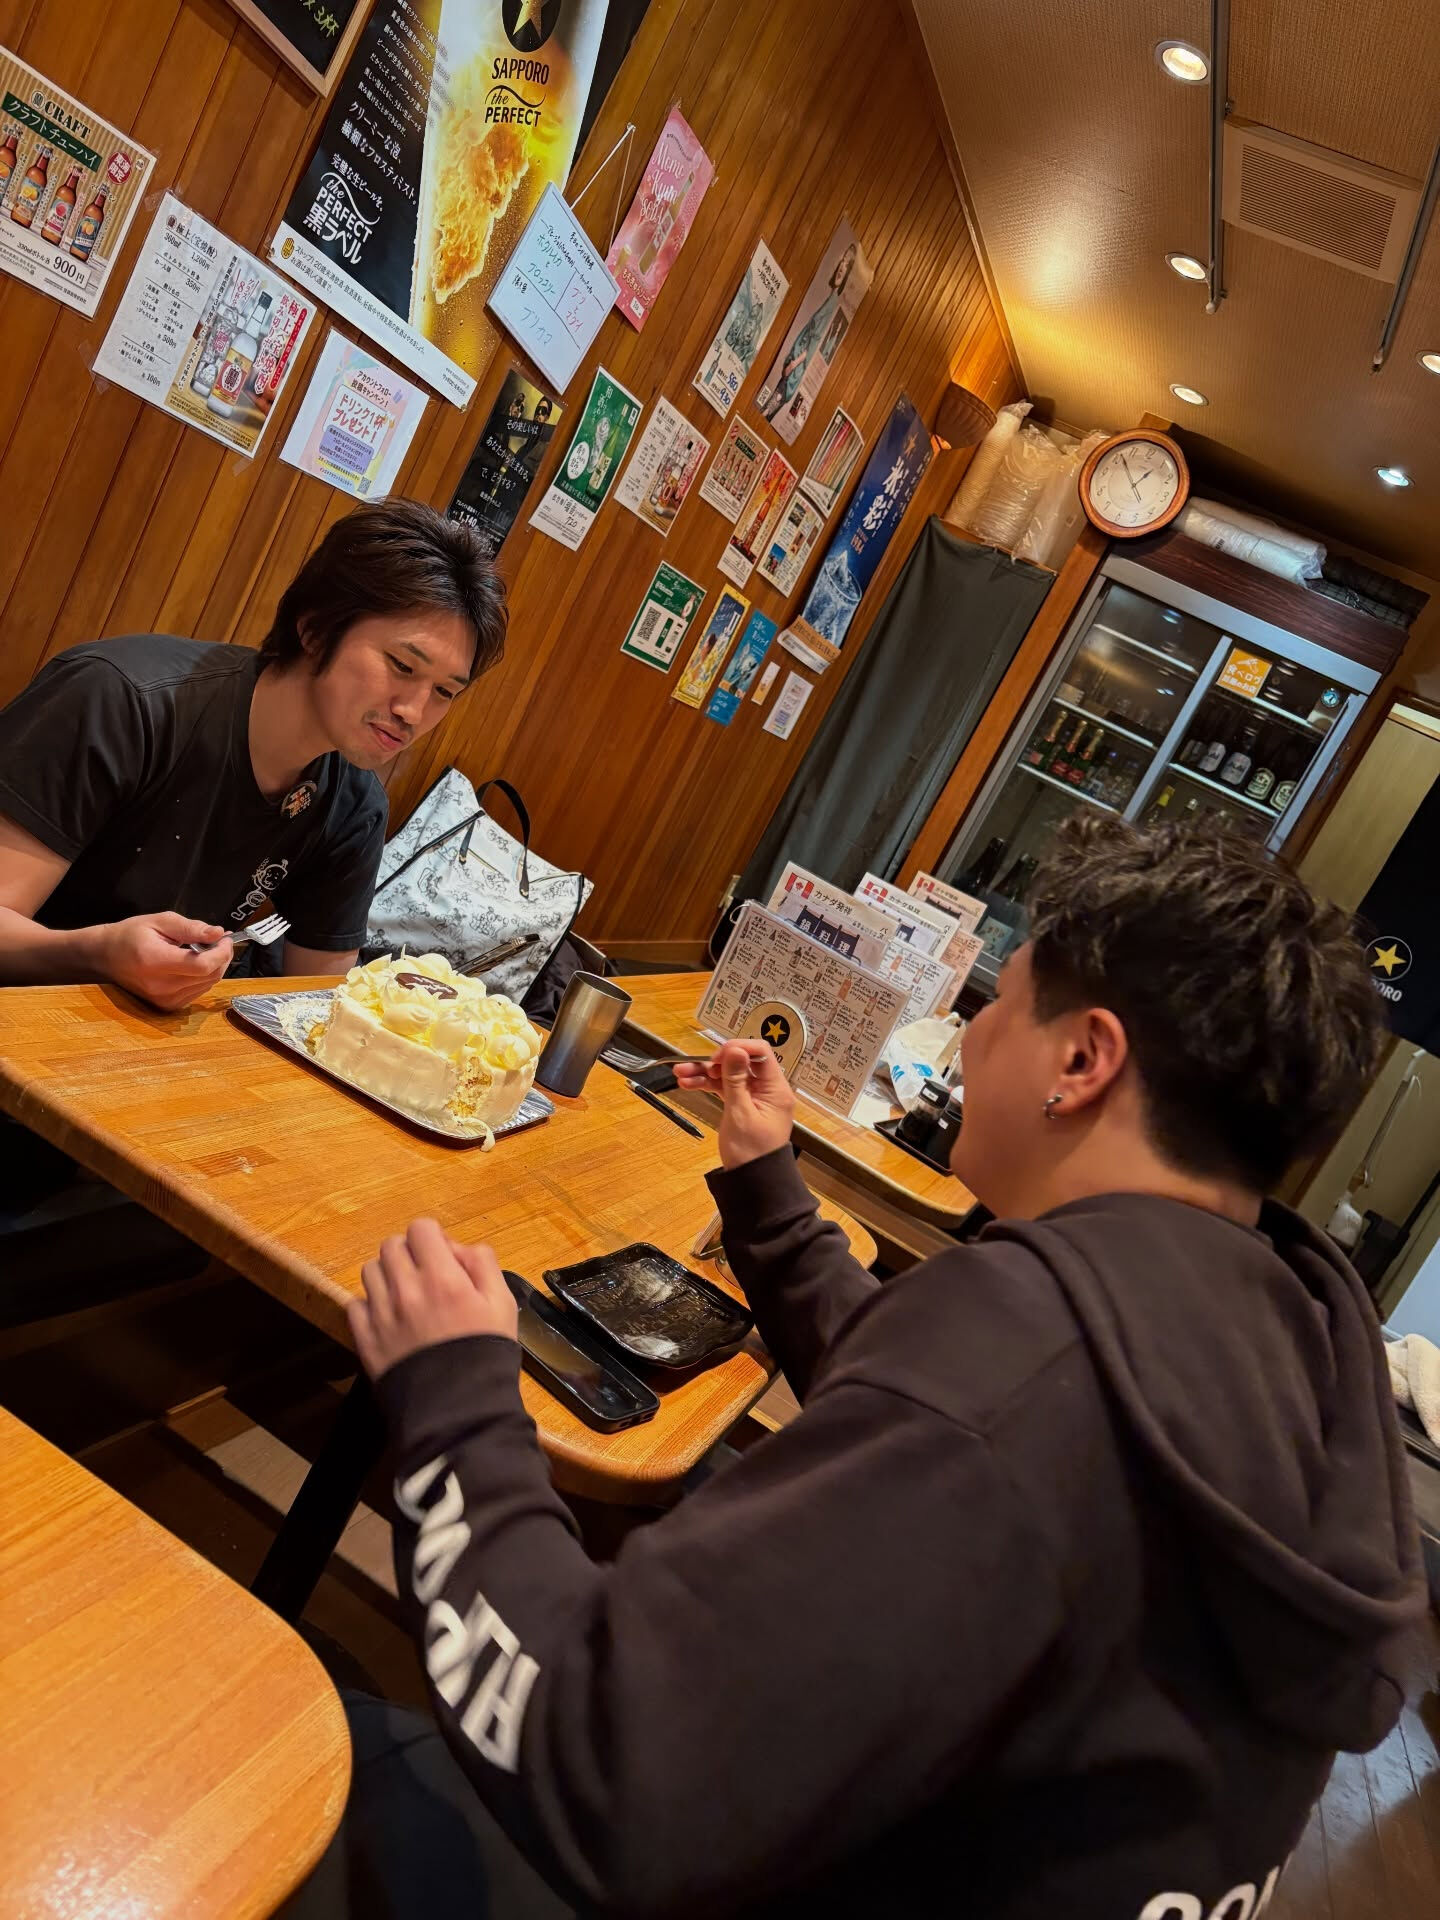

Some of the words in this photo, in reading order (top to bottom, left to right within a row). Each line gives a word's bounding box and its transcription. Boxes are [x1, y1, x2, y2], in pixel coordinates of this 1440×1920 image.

[491, 57, 550, 85] SAPPORO
[485, 105, 541, 126] PERFECT
[490, 90, 509, 107] the
[7, 96, 97, 170] クラフトチューハイ
[43, 99, 91, 141] CRAFT
[348, 99, 404, 163] クリーミーな泡、
[325, 173, 347, 201] the
[315, 188, 372, 244] PERFECT
[303, 200, 366, 268] 黒ラベル
[535, 231, 562, 271] ホタルイカ
[52, 255, 85, 284] 900円
[527, 259, 556, 301] ブロッコリー
[356, 370, 391, 398] アカウントフォロー
[717, 385, 732, 407] 930
[331, 407, 377, 443] プレゼント!
[339, 393, 385, 431] ドリンク1杯
[564, 515, 577, 530] 720
[812, 889, 853, 916] カナダ発祥
[797, 917, 852, 952] 鍋料理
